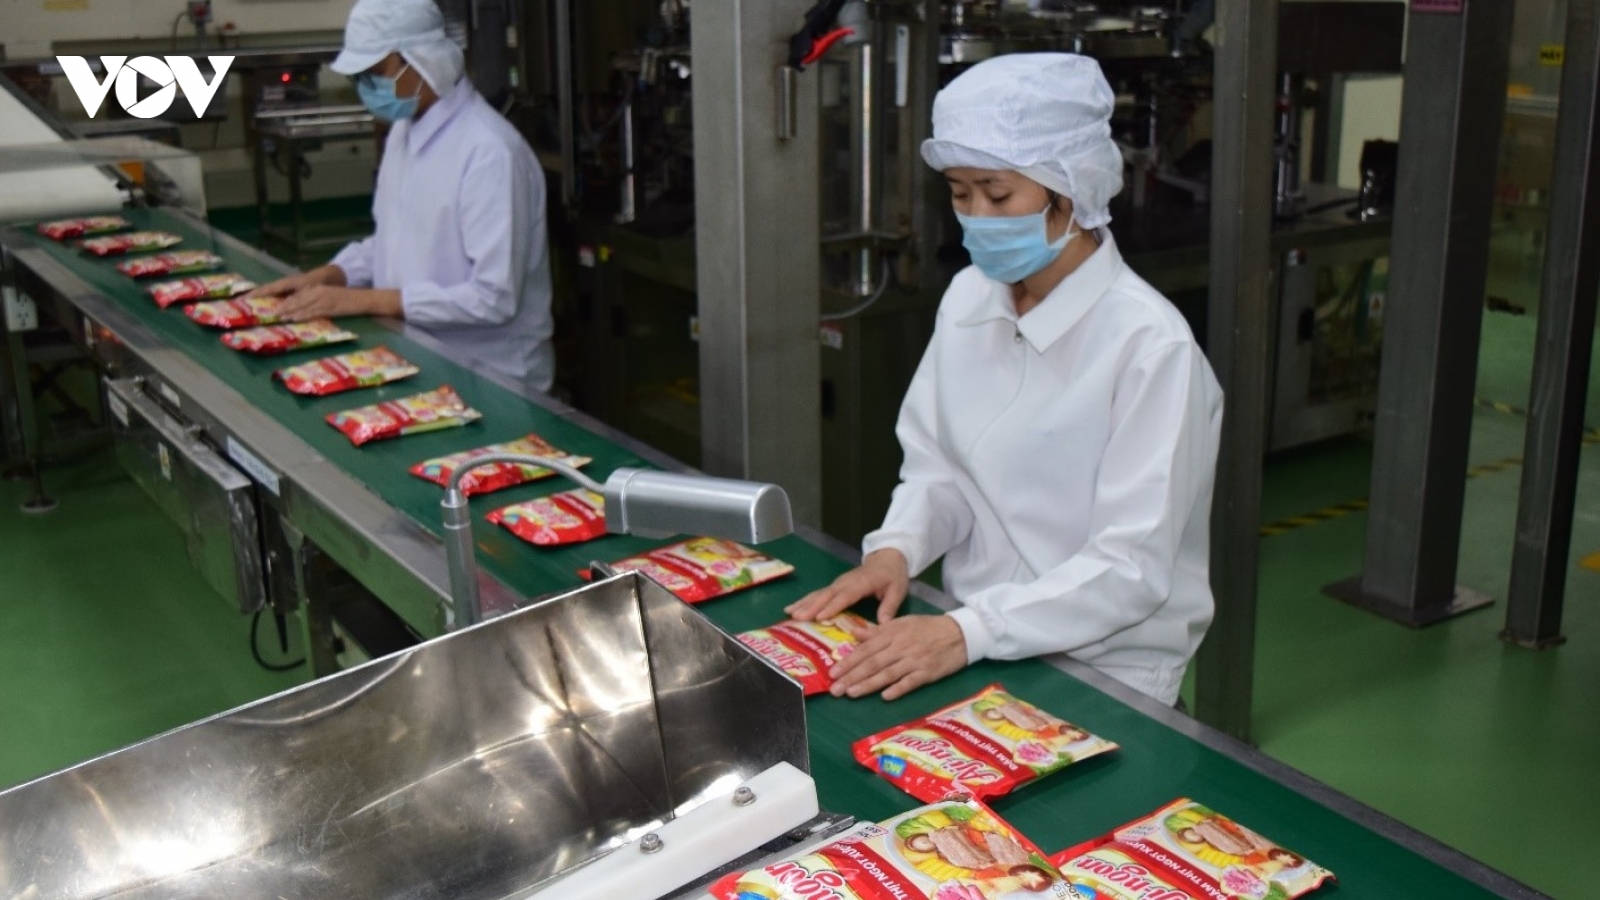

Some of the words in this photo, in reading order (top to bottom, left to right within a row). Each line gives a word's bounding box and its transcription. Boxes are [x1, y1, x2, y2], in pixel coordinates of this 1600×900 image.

[893, 733, 999, 784] Aji-ngon
[858, 858, 891, 885] NGỌT
[1150, 850, 1182, 871] NGỌT
[1178, 867, 1205, 886] THỊT
